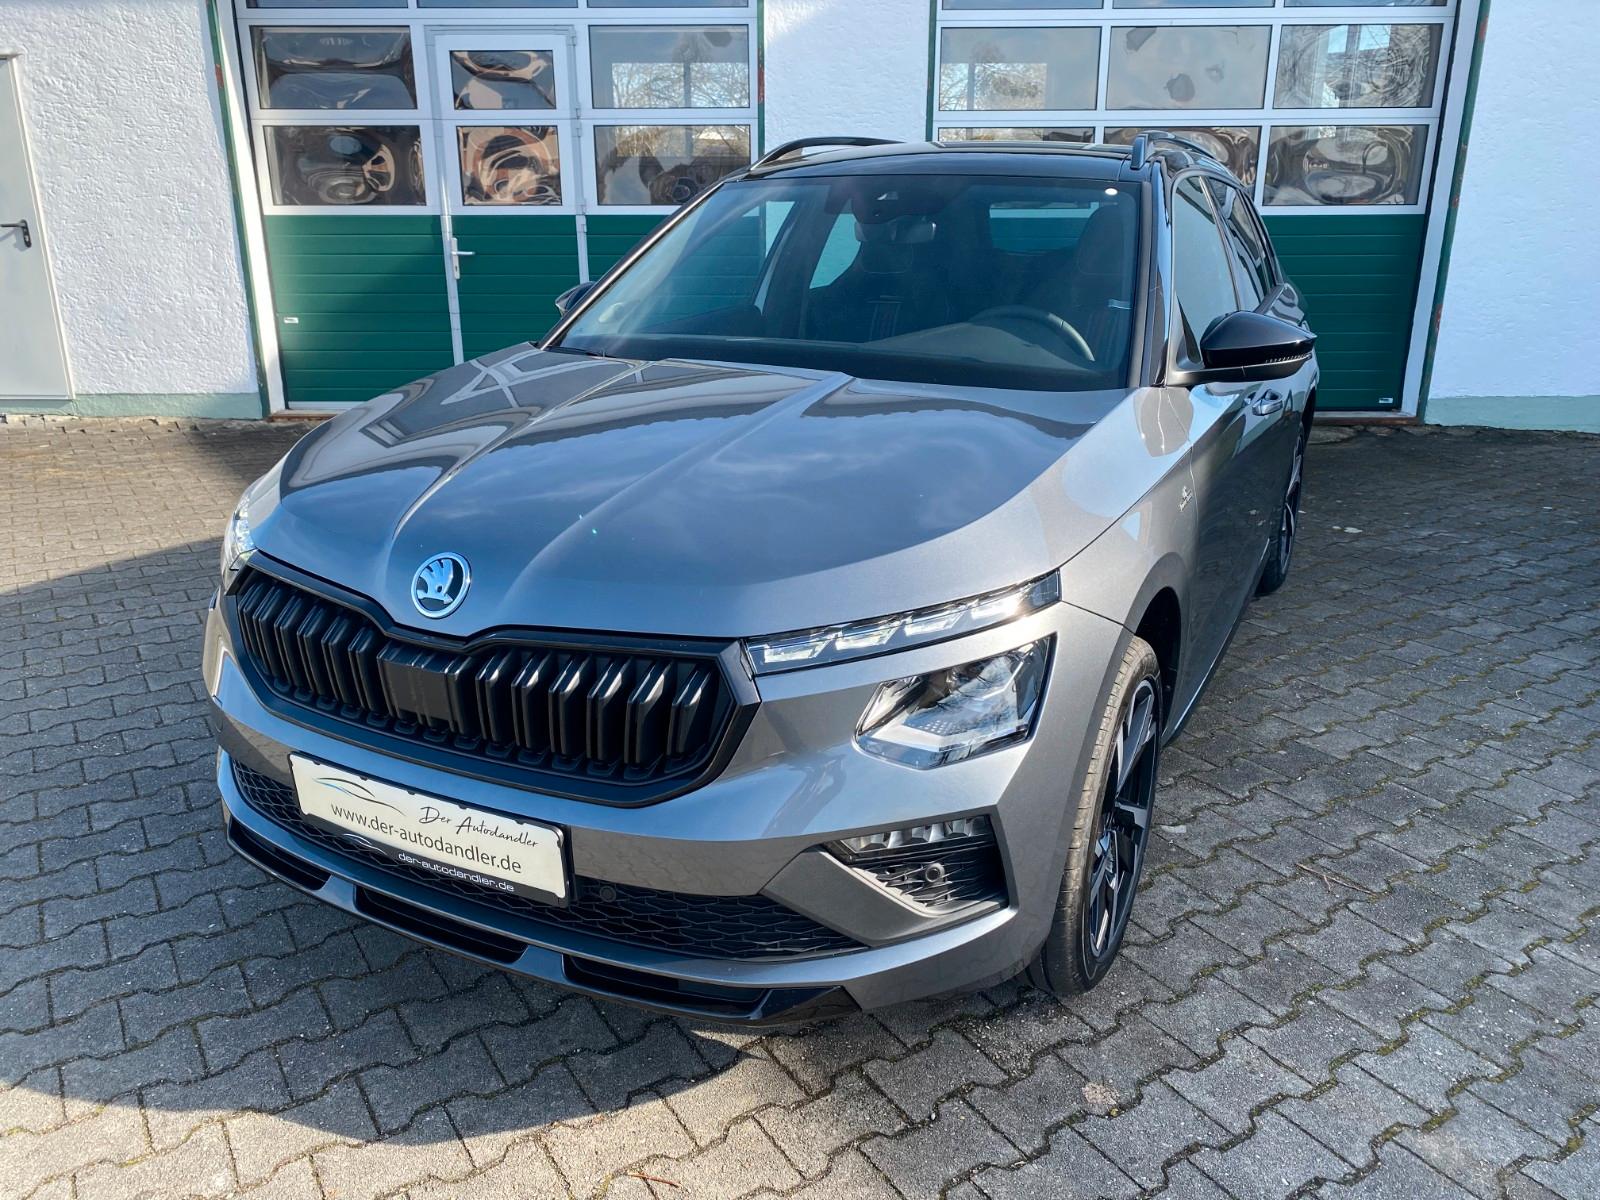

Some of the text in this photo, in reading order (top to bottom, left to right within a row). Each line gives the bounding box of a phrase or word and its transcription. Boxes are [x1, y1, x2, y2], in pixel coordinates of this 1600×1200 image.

[330, 803, 522, 874] www.der-autodandler.de
[418, 806, 539, 848] Der Autodandler
[398, 852, 515, 893] der-autodandler.de
